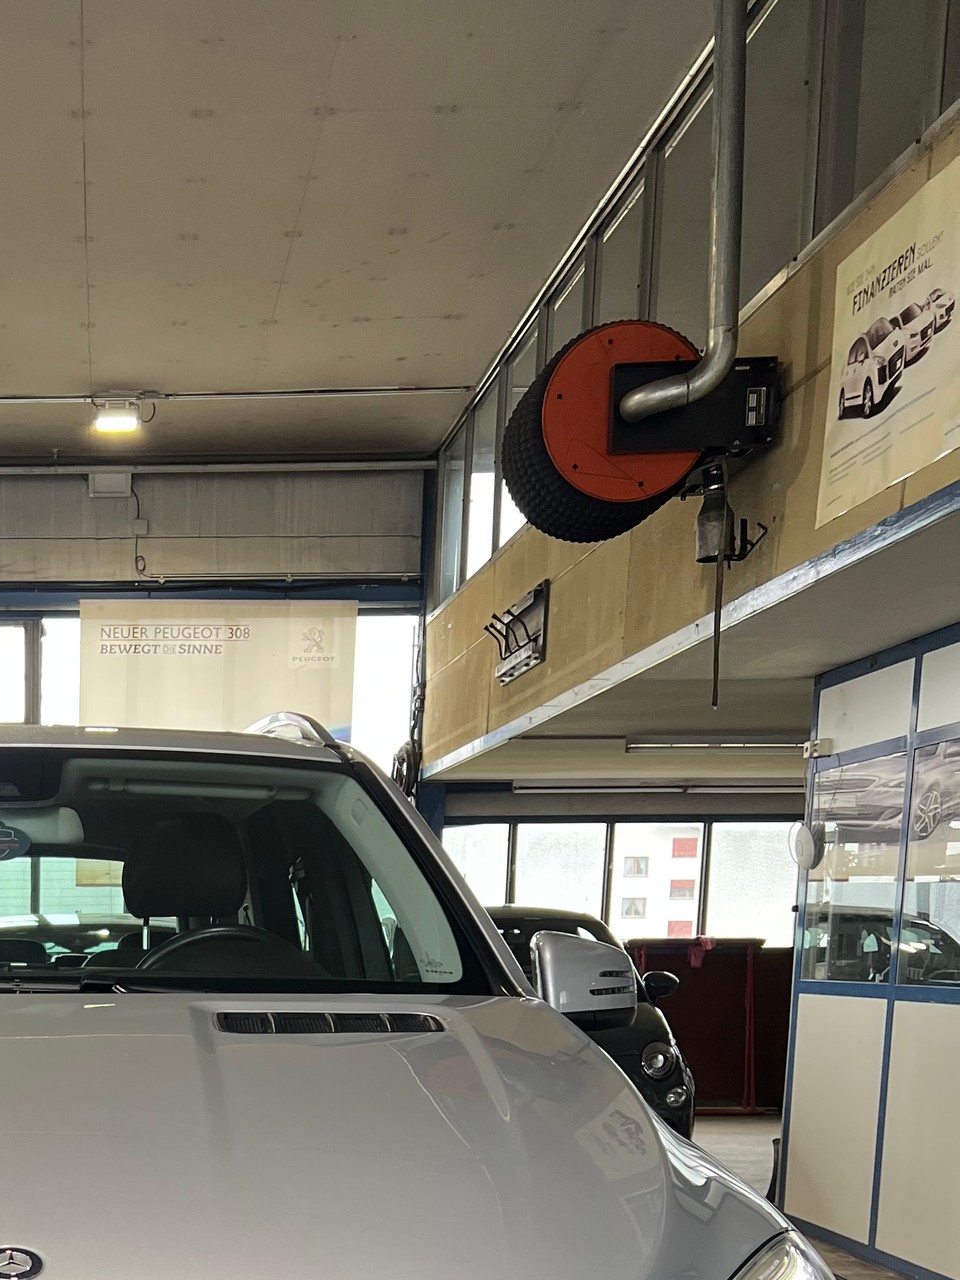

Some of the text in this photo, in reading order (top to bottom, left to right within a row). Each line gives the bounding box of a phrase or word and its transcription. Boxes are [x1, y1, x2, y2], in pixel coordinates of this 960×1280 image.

[852, 242, 916, 316] FINANZIEREN
[100, 627, 250, 639] NEUER PEUGEOT 308
[100, 644, 223, 654] BEWEGT DIE SINNE
